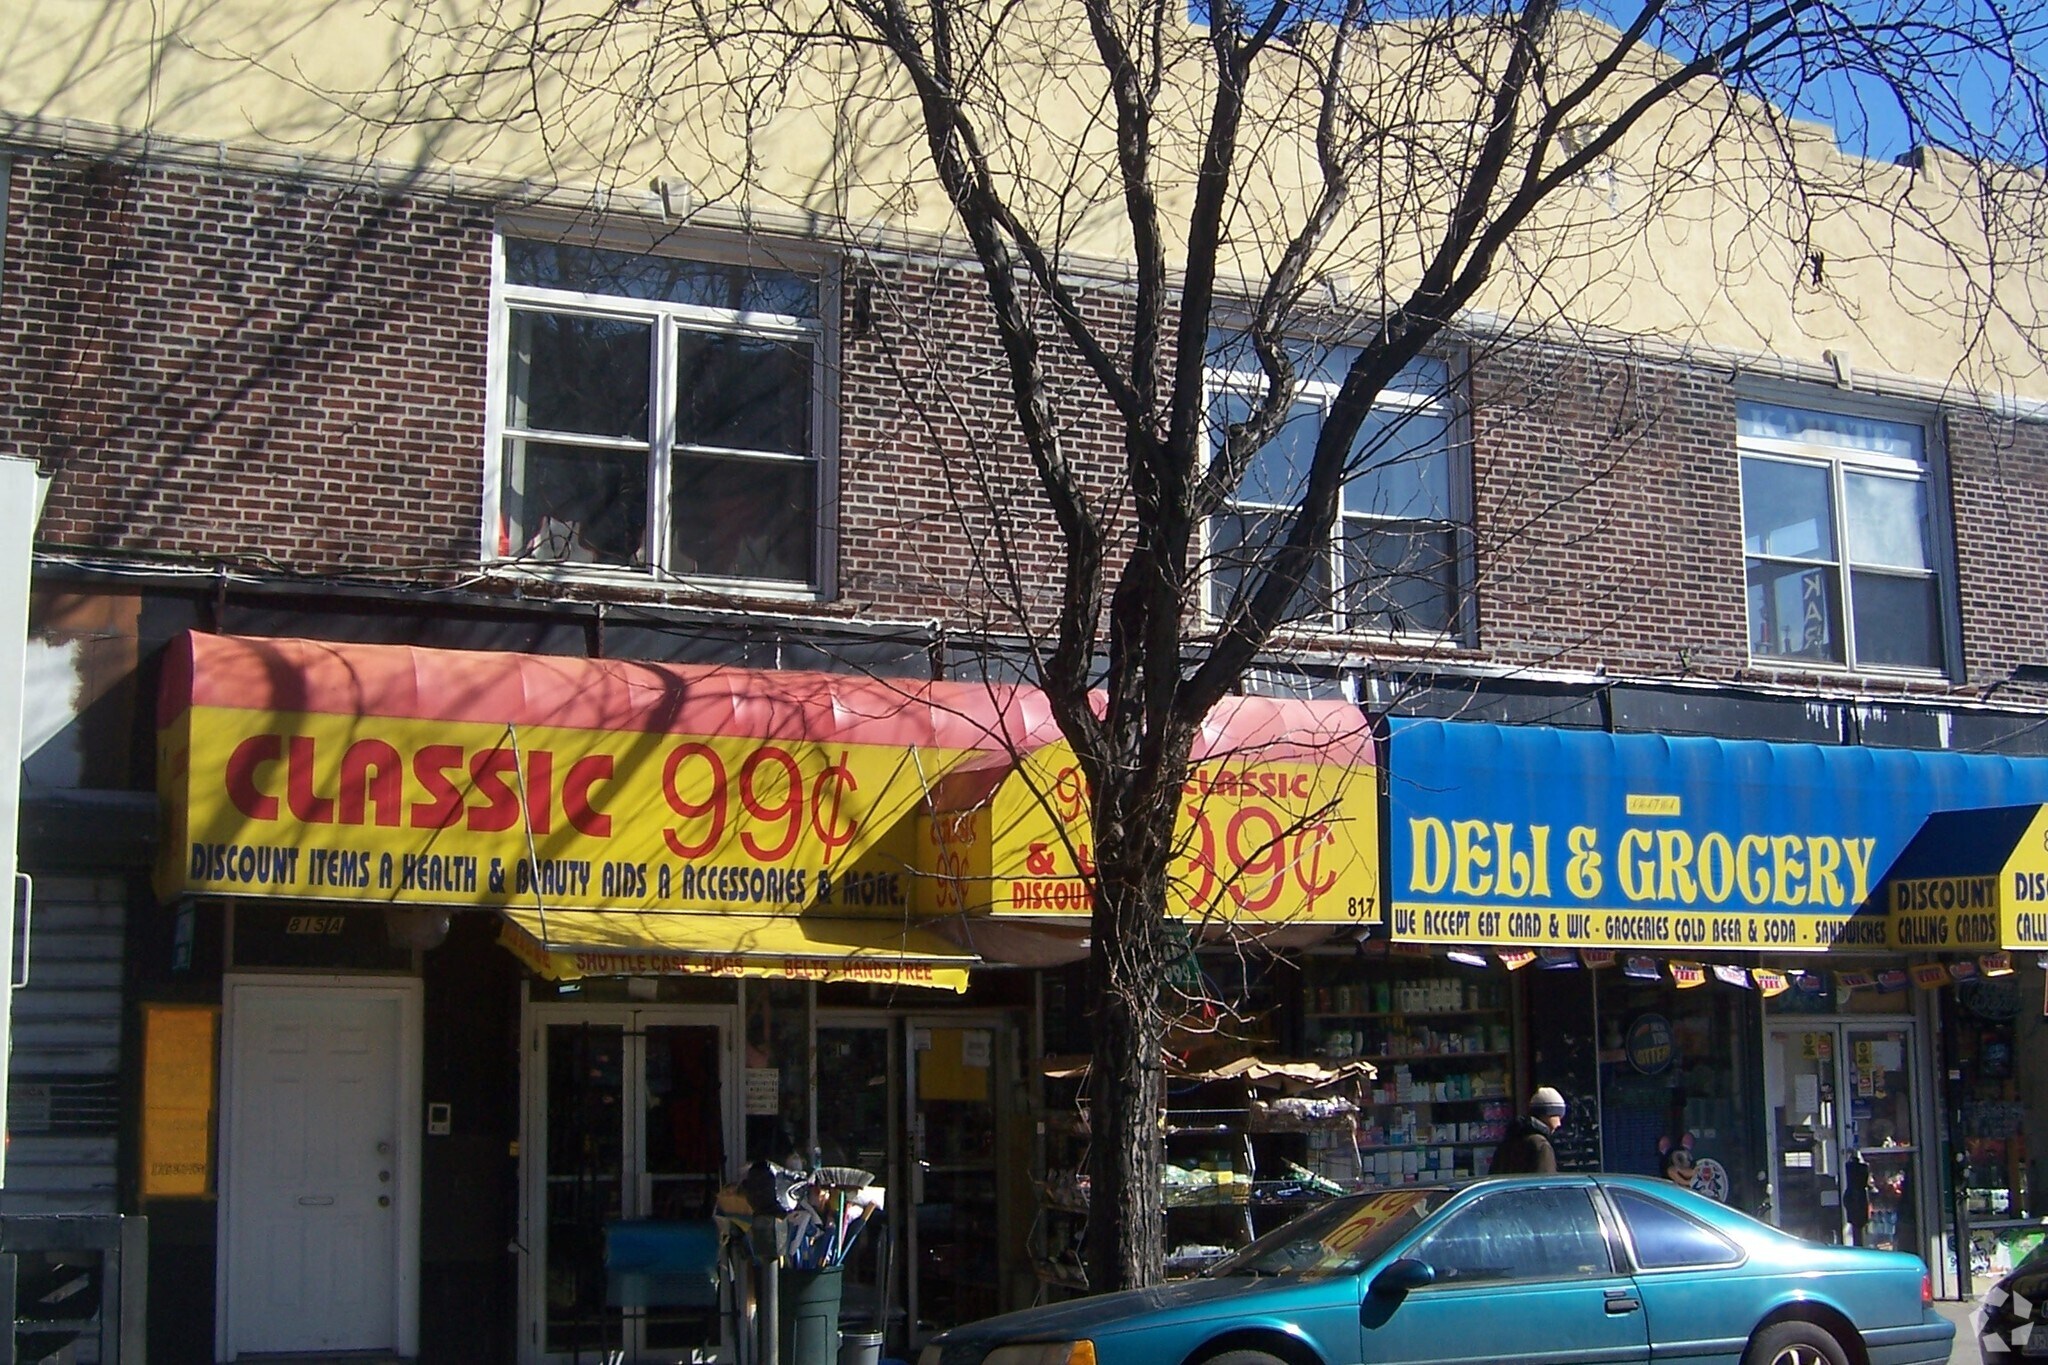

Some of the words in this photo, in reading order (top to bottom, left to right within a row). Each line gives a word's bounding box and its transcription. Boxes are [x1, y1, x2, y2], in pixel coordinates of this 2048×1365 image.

[225, 734, 614, 838] CLASSIC
[662, 742, 858, 865] 99¢
[1181, 770, 1308, 799] CLASSIC
[191, 843, 300, 884] DISCOUNT
[308, 848, 371, 888] ITEMS
[402, 853, 478, 893] HEALTH
[489, 858, 506, 894] &
[515, 858, 591, 897] BEAUTY
[601, 862, 648, 899] AIDS
[682, 864, 806, 904] ACCESSORIES
[816, 870, 832, 904] &
[1026, 842, 1057, 876] &
[1408, 816, 1552, 898] DELI
[1565, 825, 1604, 900] &
[1617, 827, 1877, 908] GROCERY
[1897, 880, 1996, 911] DISCOUNT
[2015, 872, 2048, 902] DIS
[1347, 897, 1376, 918] 817
[1395, 908, 1416, 935] WE
[1424, 909, 1470, 937] ACCEPT
[1478, 912, 1500, 937] EBT
[1508, 912, 1542, 938] CARD
[1549, 914, 1560, 938] &
[1567, 913, 1591, 939] WIC
[1605, 915, 1669, 941] GROCERIES
[1674, 918, 1706, 942] COLD
[1712, 918, 1742, 942] BEER
[1748, 919, 1758, 943] &
[1764, 918, 1796, 943] SODA
[1815, 919, 1886, 944] SANDWICHES
[1898, 914, 1949, 945] CALLING
[1956, 913, 1997, 942] CARDS
[576, 953, 647, 974] SHUTTLE
[650, 955, 691, 975] CASE
[703, 956, 745, 976] BAGS
[784, 959, 830, 980] BELTS
[842, 960, 893, 981] HANDS
[896, 962, 934, 981] FREE
